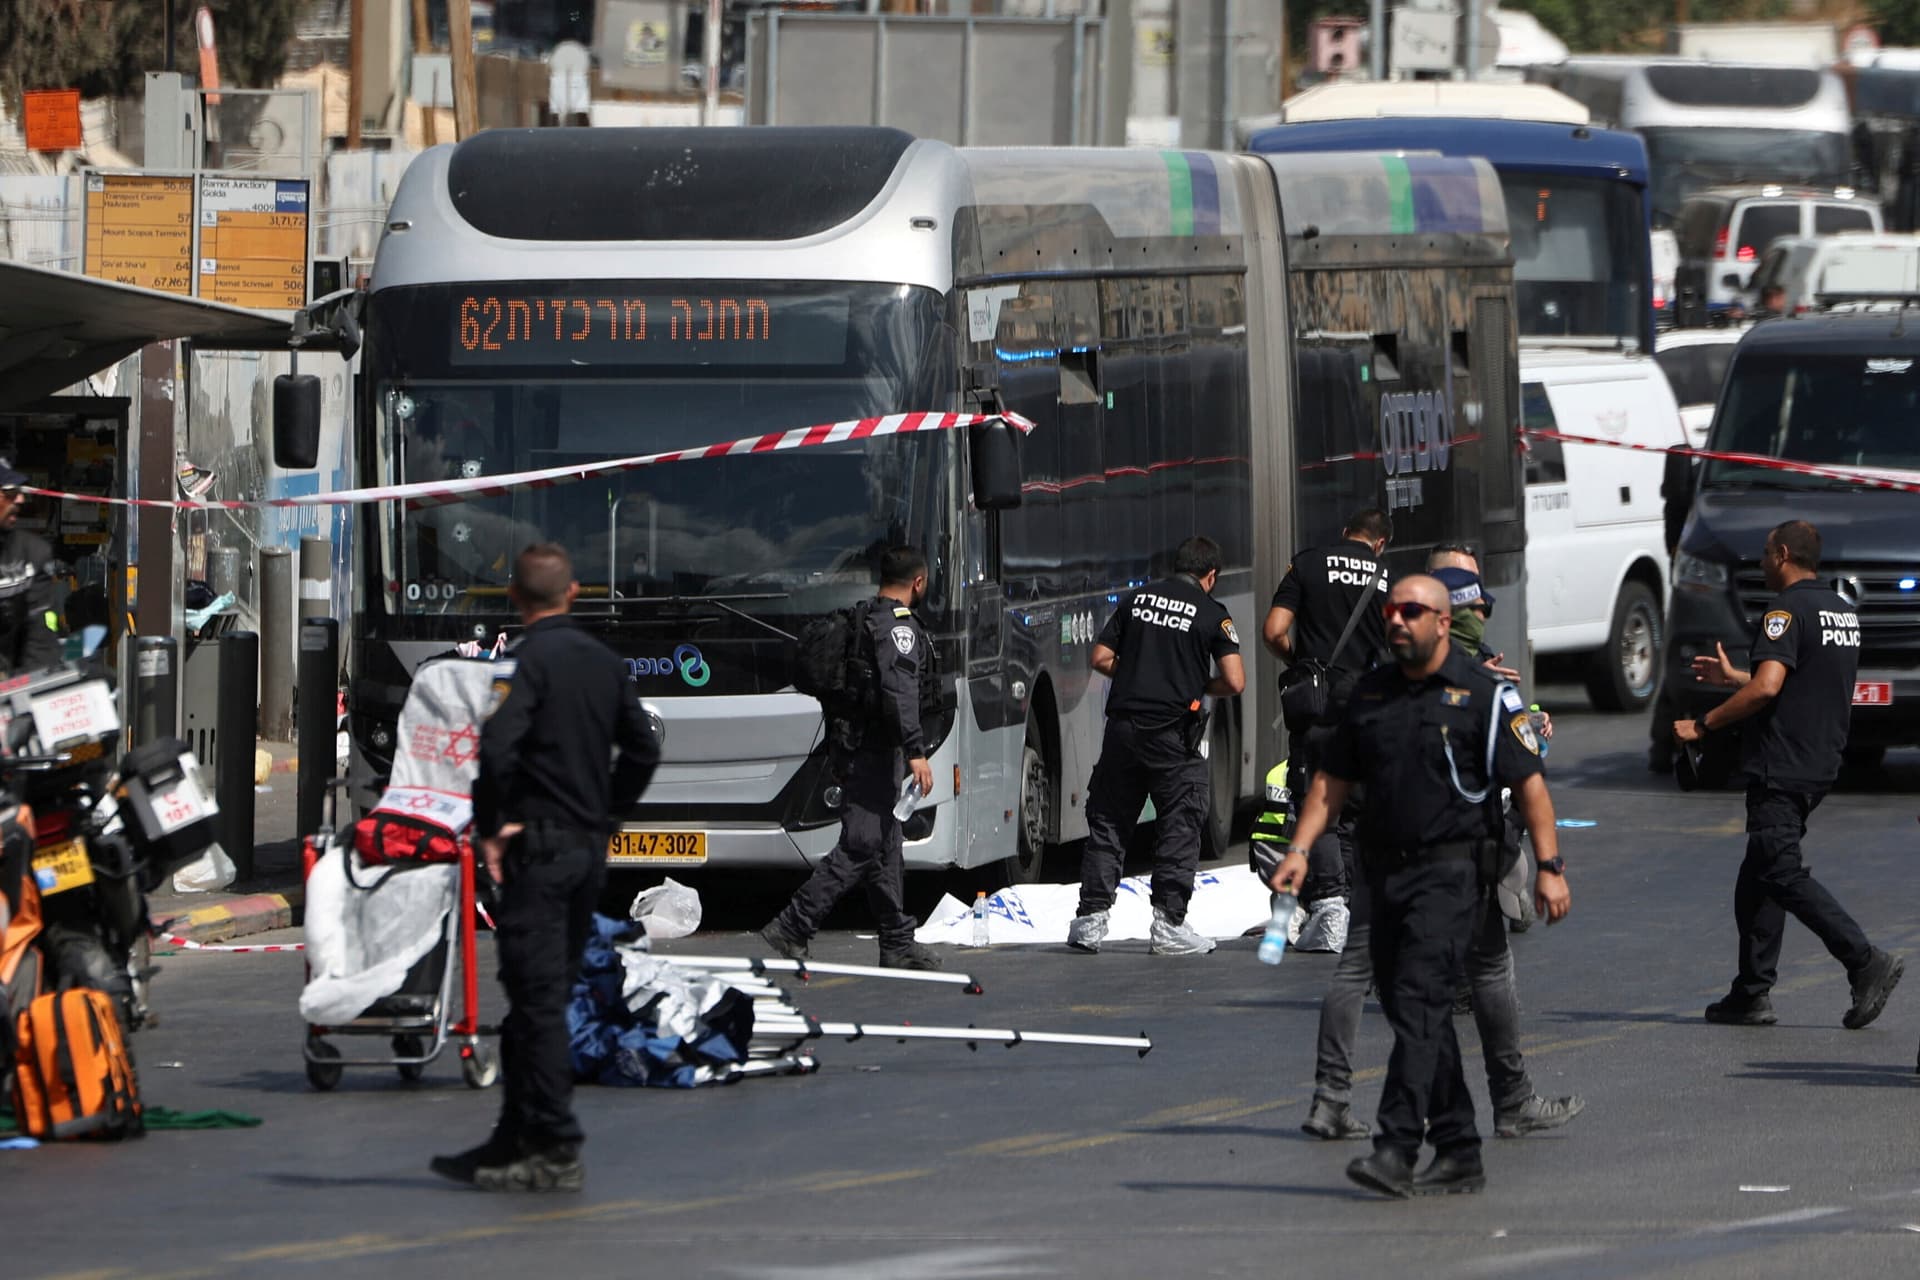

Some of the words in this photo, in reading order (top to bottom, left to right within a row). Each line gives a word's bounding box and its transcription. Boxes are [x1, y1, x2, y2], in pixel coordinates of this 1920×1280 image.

[202, 180, 230, 189] Ramot
[460, 296, 501, 351] 62
[506, 297, 647, 341] מרכזית
[670, 297, 770, 341] תחנה
[1326, 555, 1388, 578] שטרה
[1133, 593, 1198, 618] משטרה
[1131, 606, 1193, 633] POLICE
[1818, 610, 1860, 628] שטרה
[1821, 628, 1861, 647] POLIC
